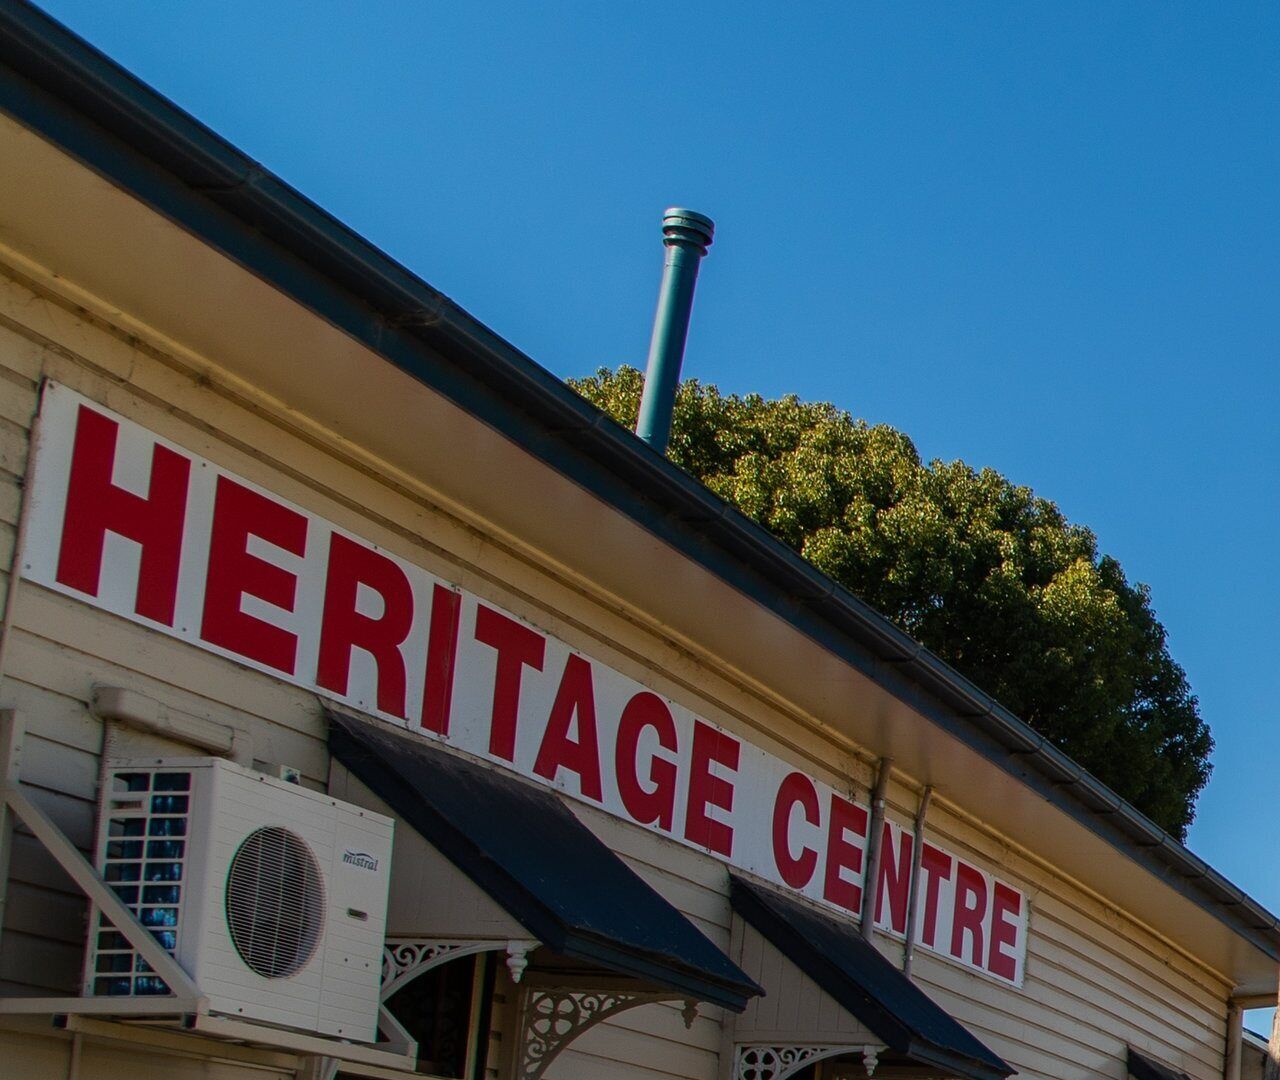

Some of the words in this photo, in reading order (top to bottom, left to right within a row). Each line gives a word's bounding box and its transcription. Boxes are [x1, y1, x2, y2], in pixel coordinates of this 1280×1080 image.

[57, 406, 740, 855] HERITAGE
[772, 772, 1021, 982] CENTRE
[343, 853, 378, 871] mistral
